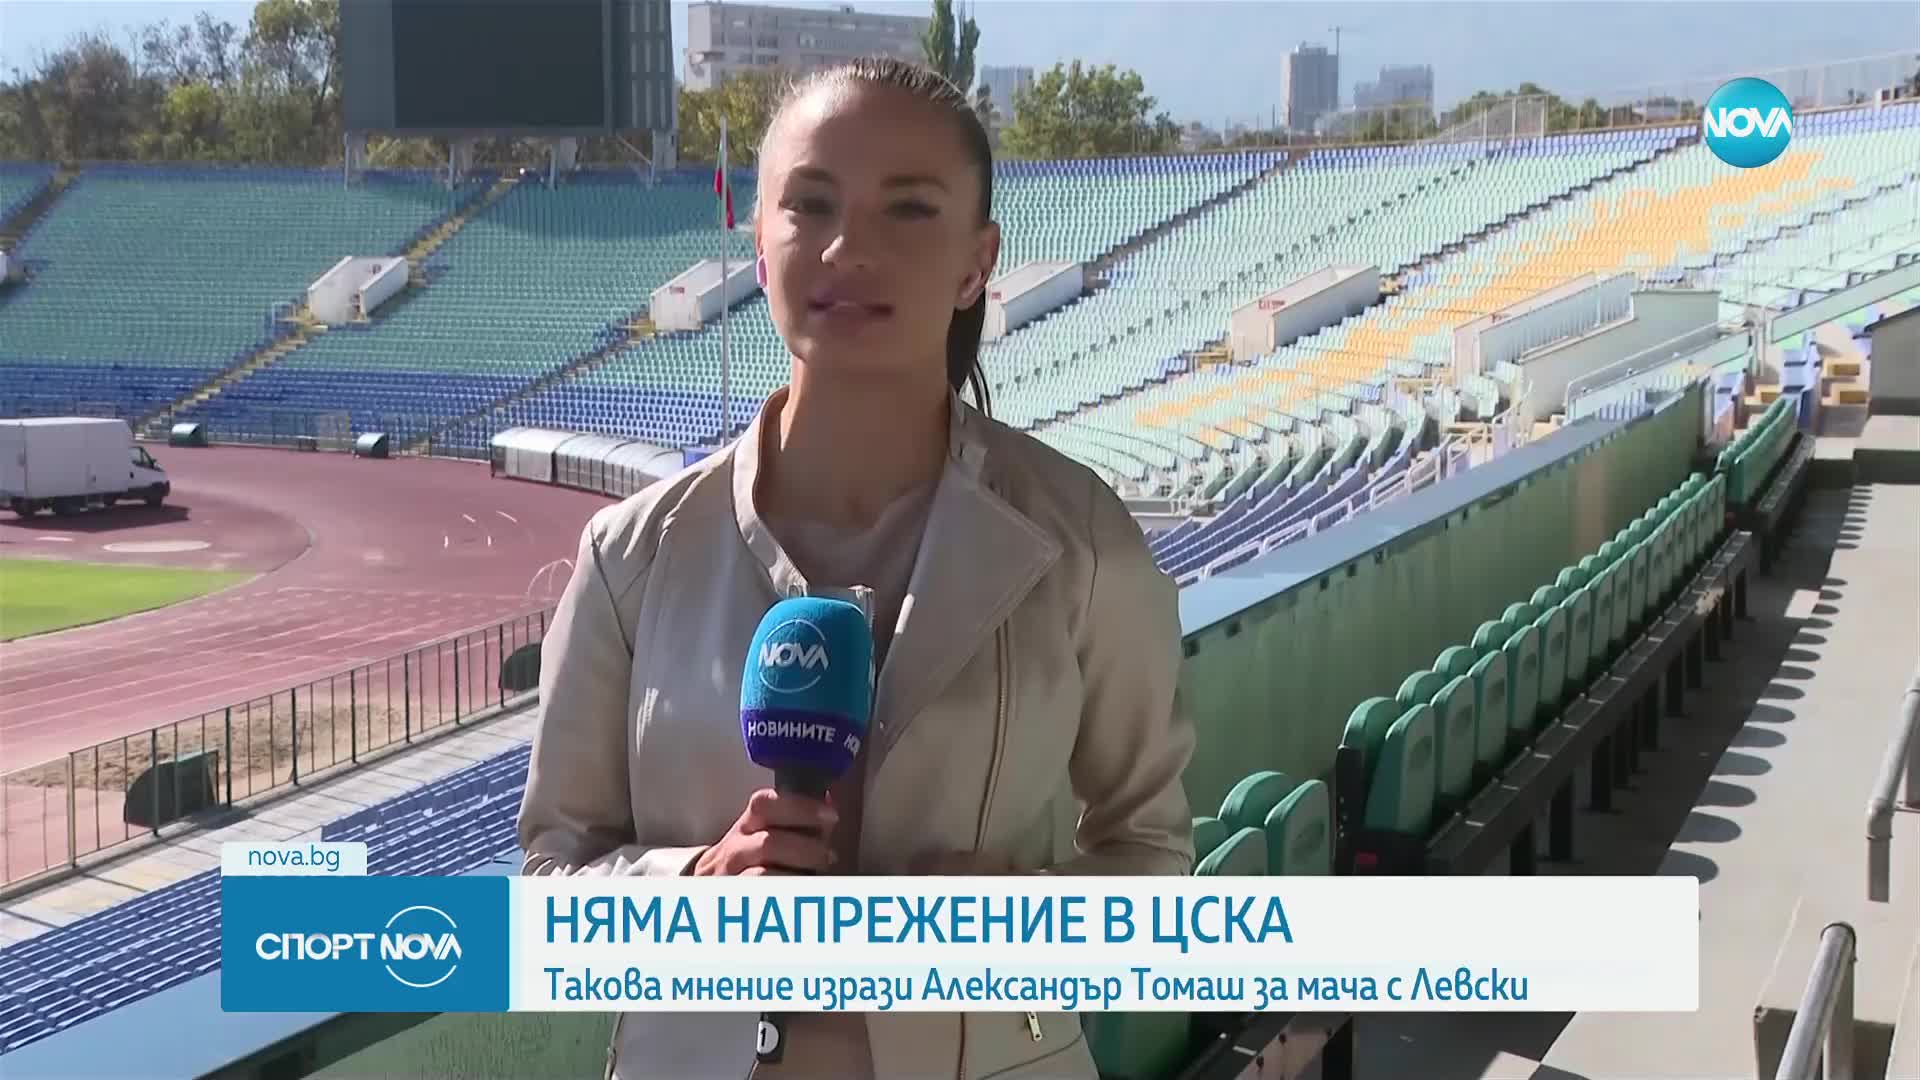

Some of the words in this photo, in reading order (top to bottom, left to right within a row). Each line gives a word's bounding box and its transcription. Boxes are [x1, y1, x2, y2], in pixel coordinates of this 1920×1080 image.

[758, 642, 830, 671] NOVA
[747, 720, 837, 743] НОВИНИТЕ
[760, 1027, 767, 1047] 1
